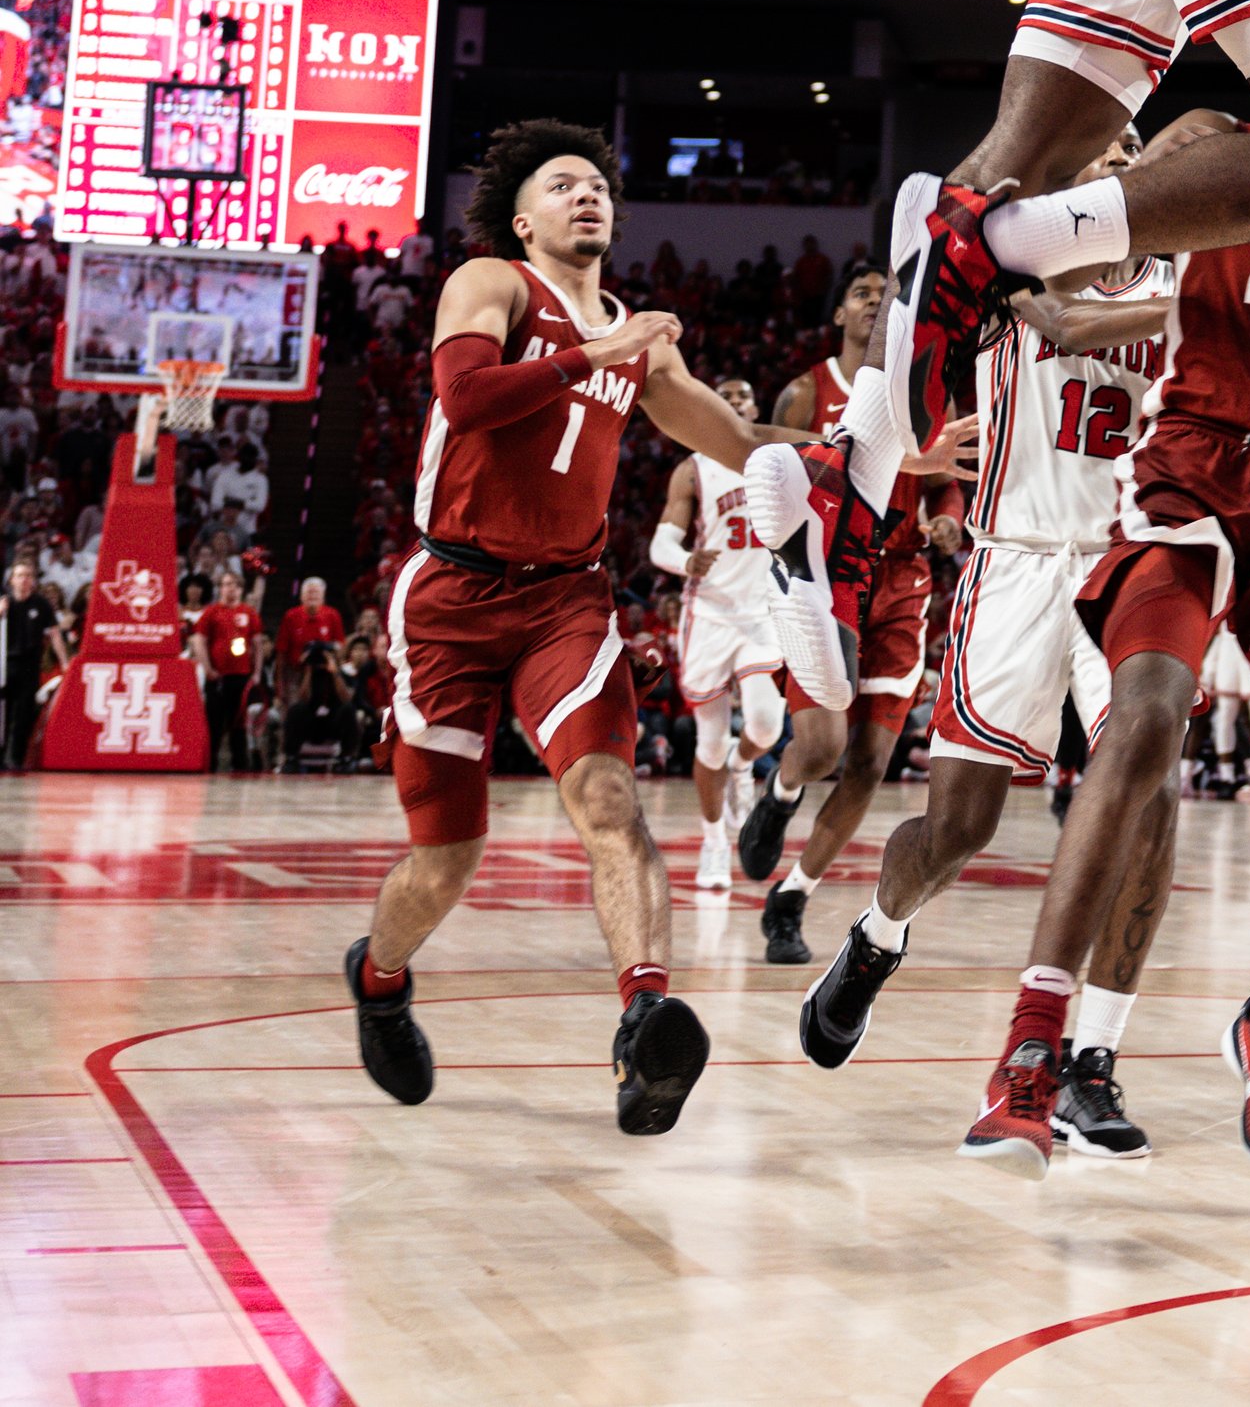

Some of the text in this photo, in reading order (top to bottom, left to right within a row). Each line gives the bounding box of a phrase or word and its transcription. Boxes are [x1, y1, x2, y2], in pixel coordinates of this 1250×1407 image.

[517, 335, 637, 417] AAMA
[1035, 332, 1167, 381] HTON
[549, 401, 587, 475] 1
[1055, 378, 1132, 461] 12
[82, 662, 176, 753] UH
